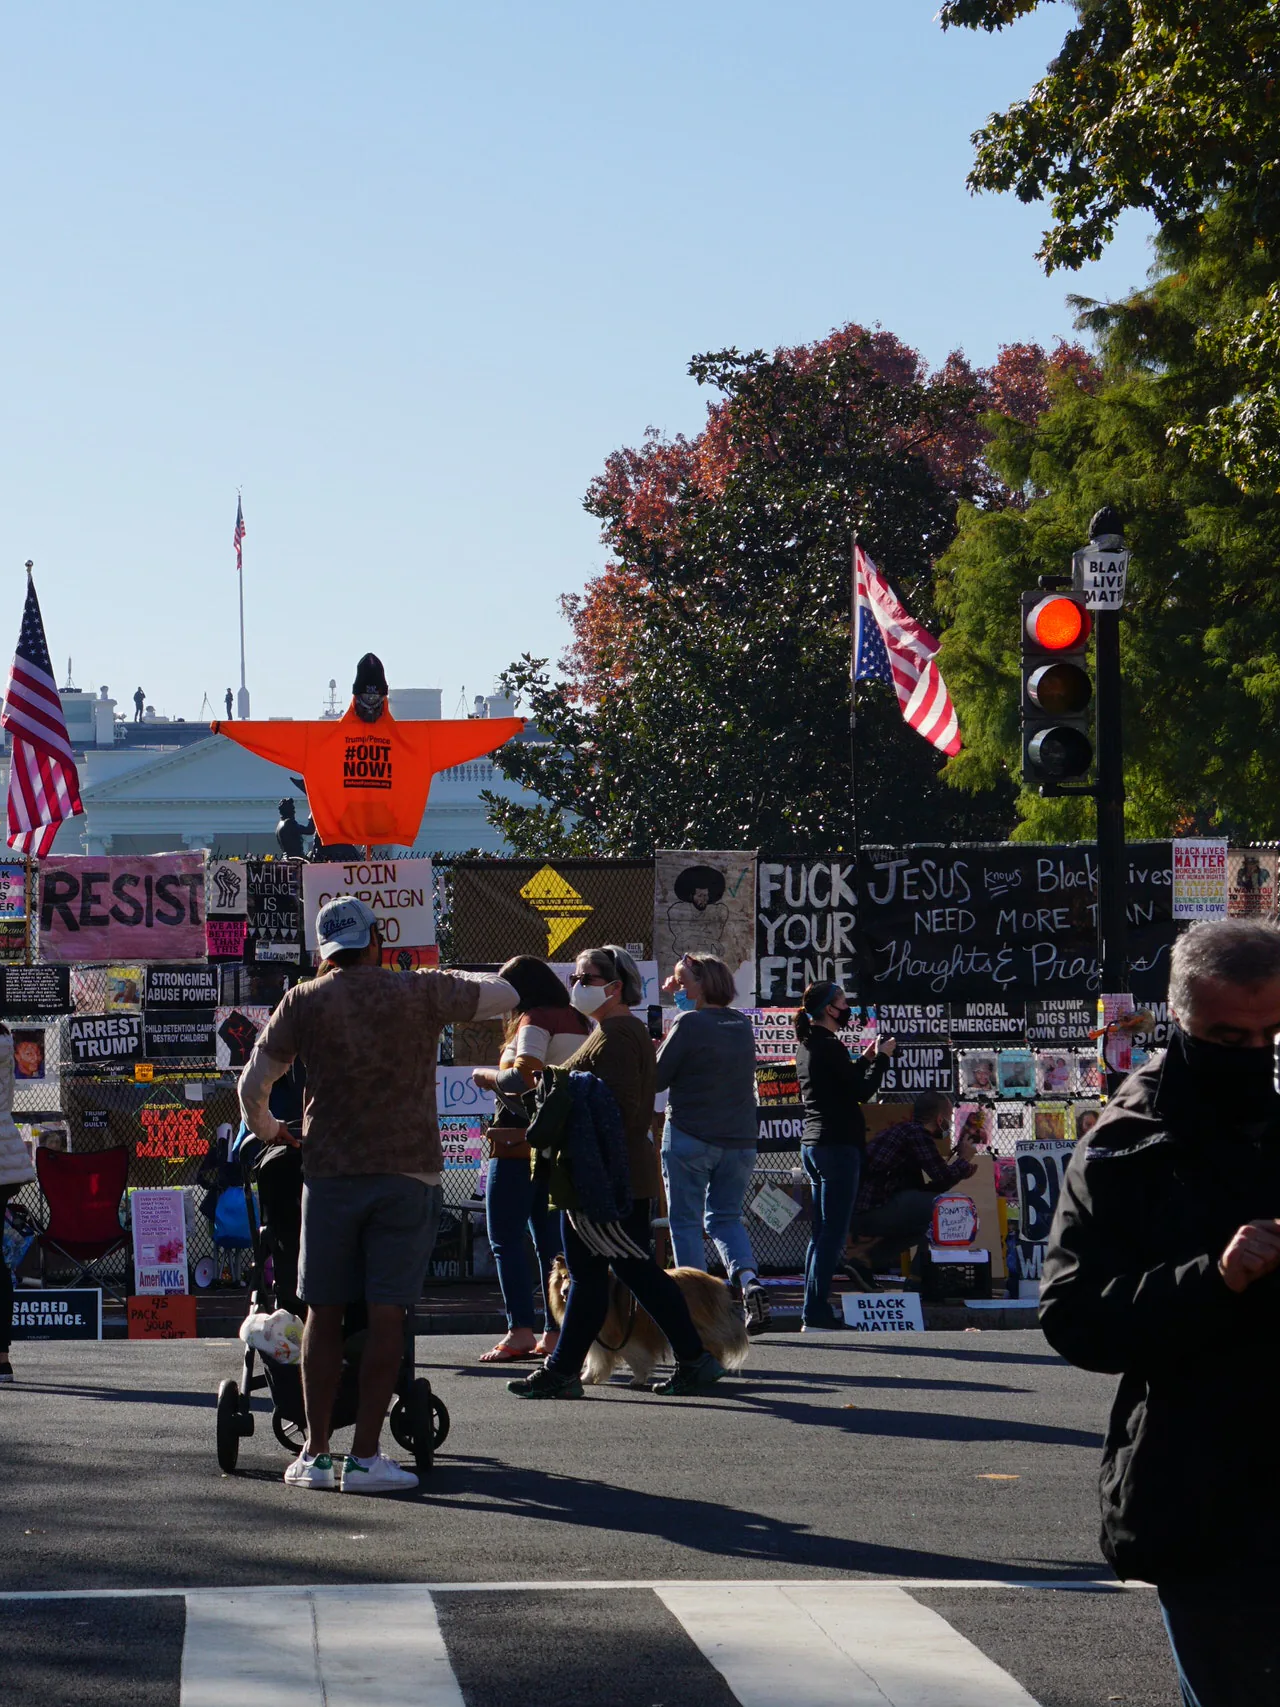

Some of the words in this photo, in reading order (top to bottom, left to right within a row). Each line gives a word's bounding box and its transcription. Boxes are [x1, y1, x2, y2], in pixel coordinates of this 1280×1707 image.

[345, 746, 391, 762] #OUT
[344, 762, 392, 777] NOW!
[1175, 856, 1225, 867] MATTER
[250, 864, 296, 883] WHITE
[344, 864, 396, 884] JOIN
[867, 859, 970, 904] JESUS
[984, 868, 1021, 888] knows
[1037, 853, 1098, 892] Black
[248, 883, 296, 896] SILENCE
[759, 862, 858, 909] FUCK
[40, 871, 202, 932] RESIST
[264, 897, 276, 910] IS
[247, 912, 297, 928] VIOLENCE
[914, 908, 976, 935] NEED
[996, 908, 1070, 935] MORE
[758, 912, 857, 955] YOUR
[215, 946, 238, 954] THIS
[152, 973, 212, 986] STRONGMEN
[148, 989, 178, 1000] ABUSE
[182, 988, 217, 1001] POWER
[881, 1005, 923, 1018] STATE
[926, 1004, 943, 1018] OF
[967, 1003, 1008, 1016] MORAL
[1041, 1000, 1084, 1011] TRUMP
[1036, 1012, 1065, 1025] DIGS
[1070, 1012, 1090, 1024] HIS
[71, 1018, 140, 1039] ARREST
[145, 1024, 161, 1033] CHILD
[163, 1024, 195, 1033] DETENTION
[197, 1024, 216, 1032] CAMPS
[878, 1019, 948, 1034] INJUSTICE
[951, 1019, 1024, 1032] EMERGENCY
[153, 1034, 179, 1042] DESTROY
[180, 1034, 208, 1042] CHILDREN
[1027, 1027, 1055, 1039] OWN
[76, 1036, 138, 1057] TRUMP
[882, 1070, 896, 1088] IS
[902, 1069, 951, 1088] UNFIT
[141, 1110, 205, 1125] BLACK
[140, 1270, 184, 1287] AmeriKKKa
[13, 1302, 68, 1313] SACRED
[152, 1298, 168, 1310] 45
[858, 1300, 905, 1308] BLACK
[131, 1310, 158, 1319] PACK
[864, 1311, 903, 1319] LIVES
[857, 1322, 914, 1331] MATTER
